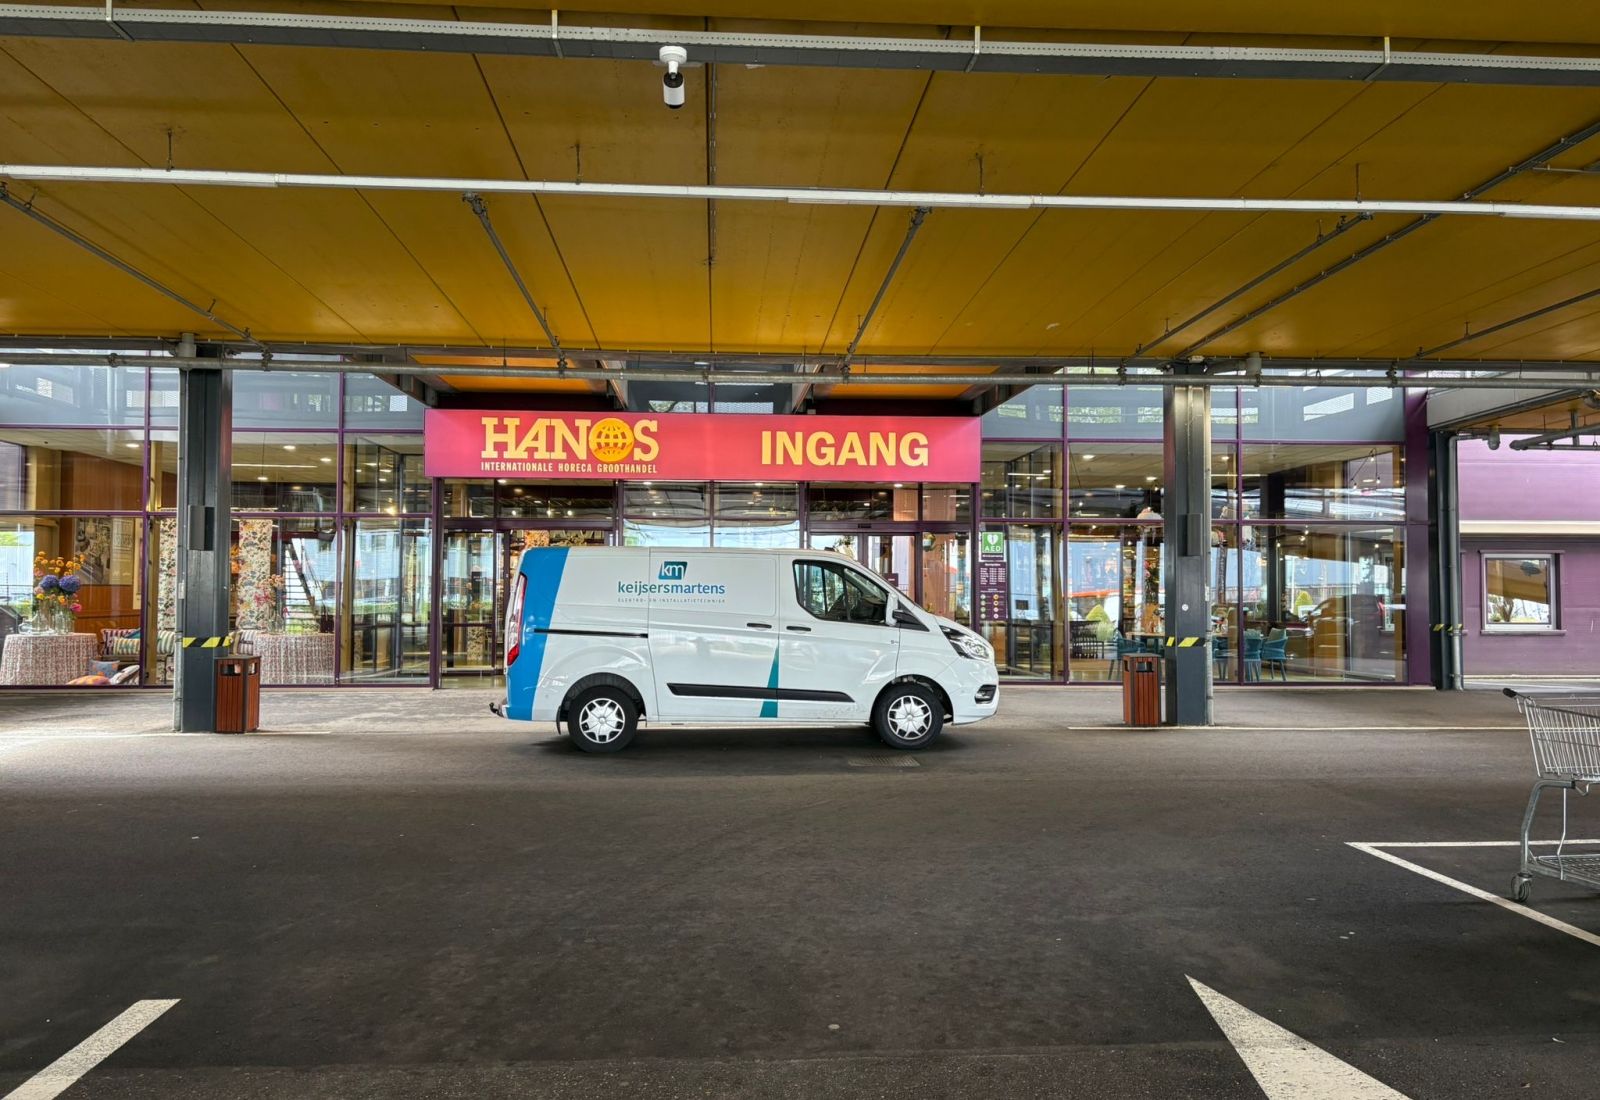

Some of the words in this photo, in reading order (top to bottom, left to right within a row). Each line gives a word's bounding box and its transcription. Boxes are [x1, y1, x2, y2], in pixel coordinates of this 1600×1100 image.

[481, 417, 660, 462] HANOS
[761, 430, 929, 467] INGANG
[481, 462, 553, 472] INTERNATIONALE
[558, 463, 592, 473] HORECA
[597, 463, 657, 474] GROOTHANDEL
[661, 564, 684, 579] km
[618, 581, 725, 596] keijsersmartens
